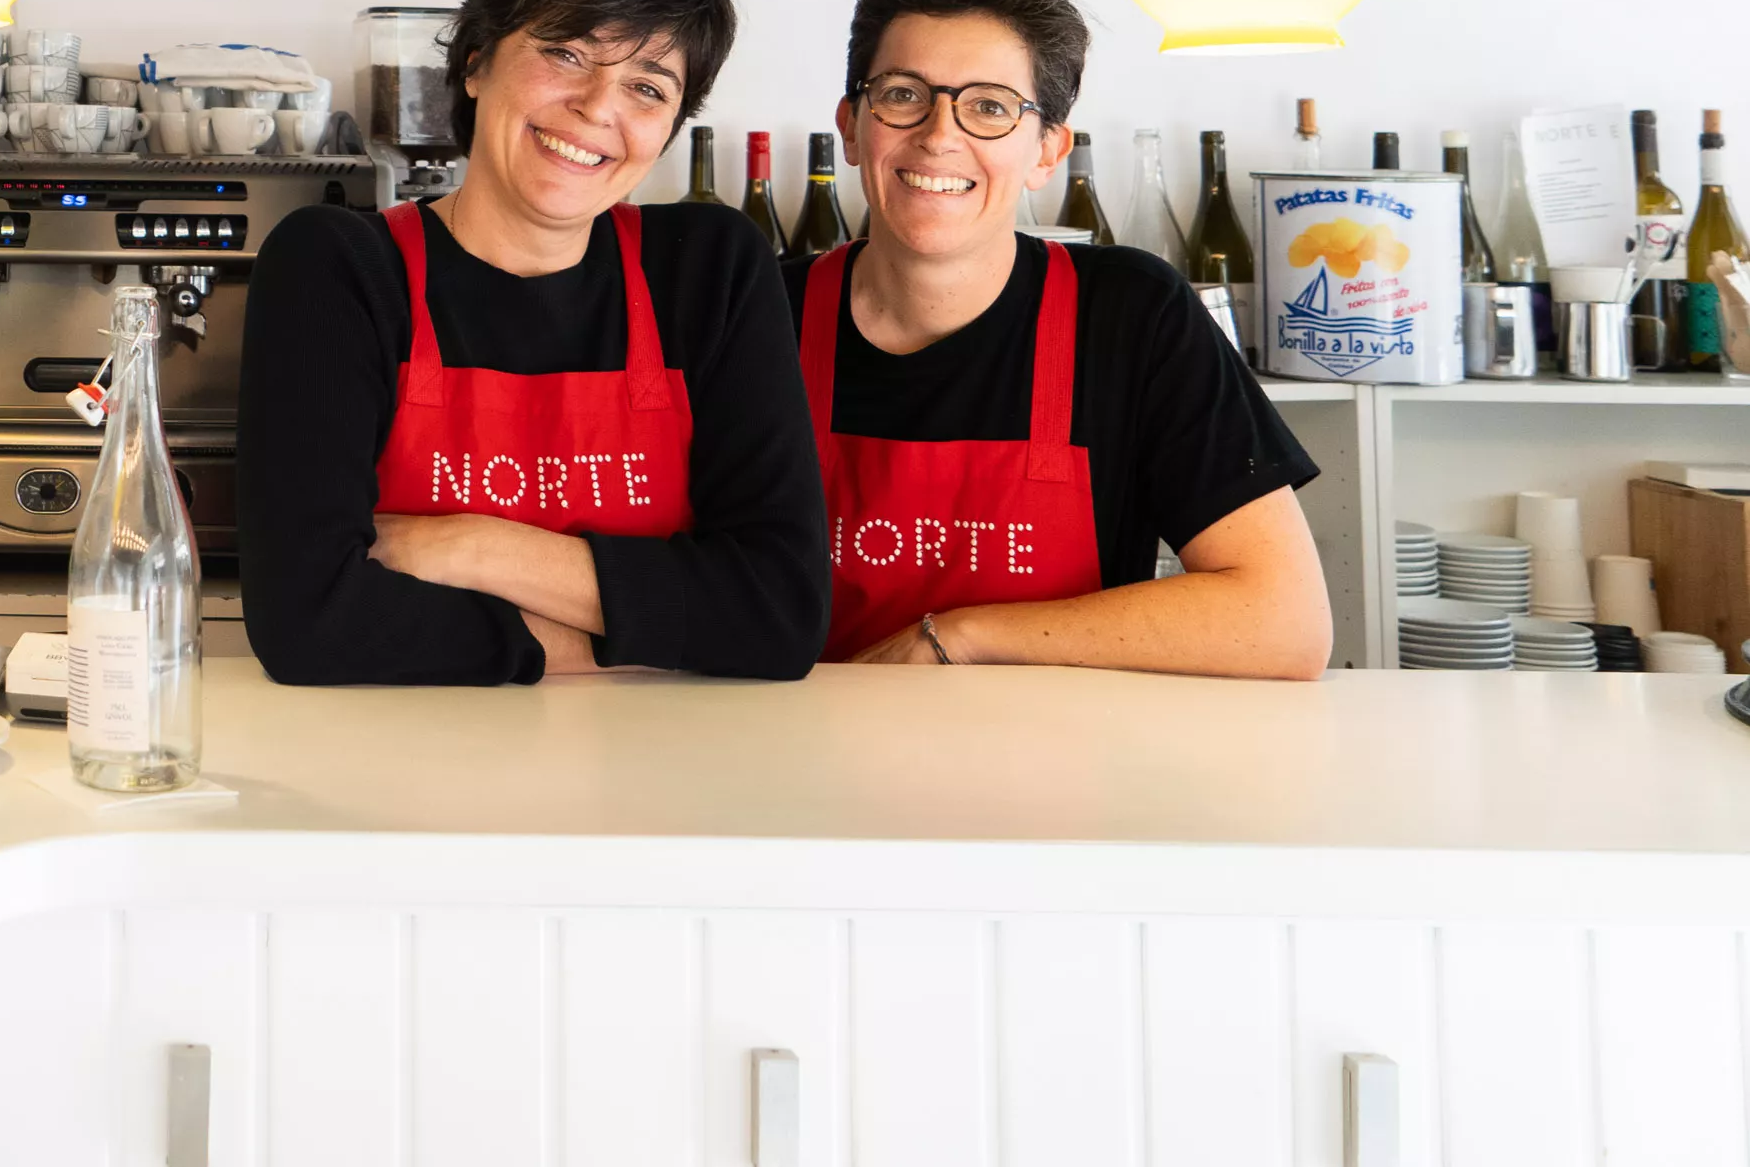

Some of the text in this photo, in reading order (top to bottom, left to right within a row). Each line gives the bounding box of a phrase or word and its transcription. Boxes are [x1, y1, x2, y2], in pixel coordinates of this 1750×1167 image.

[62, 194, 86, 206] S5
[1274, 188, 1415, 220] Patatas Fritas
[1278, 315, 1414, 355] Bonilla a la vista
[432, 451, 651, 508] NORTE
